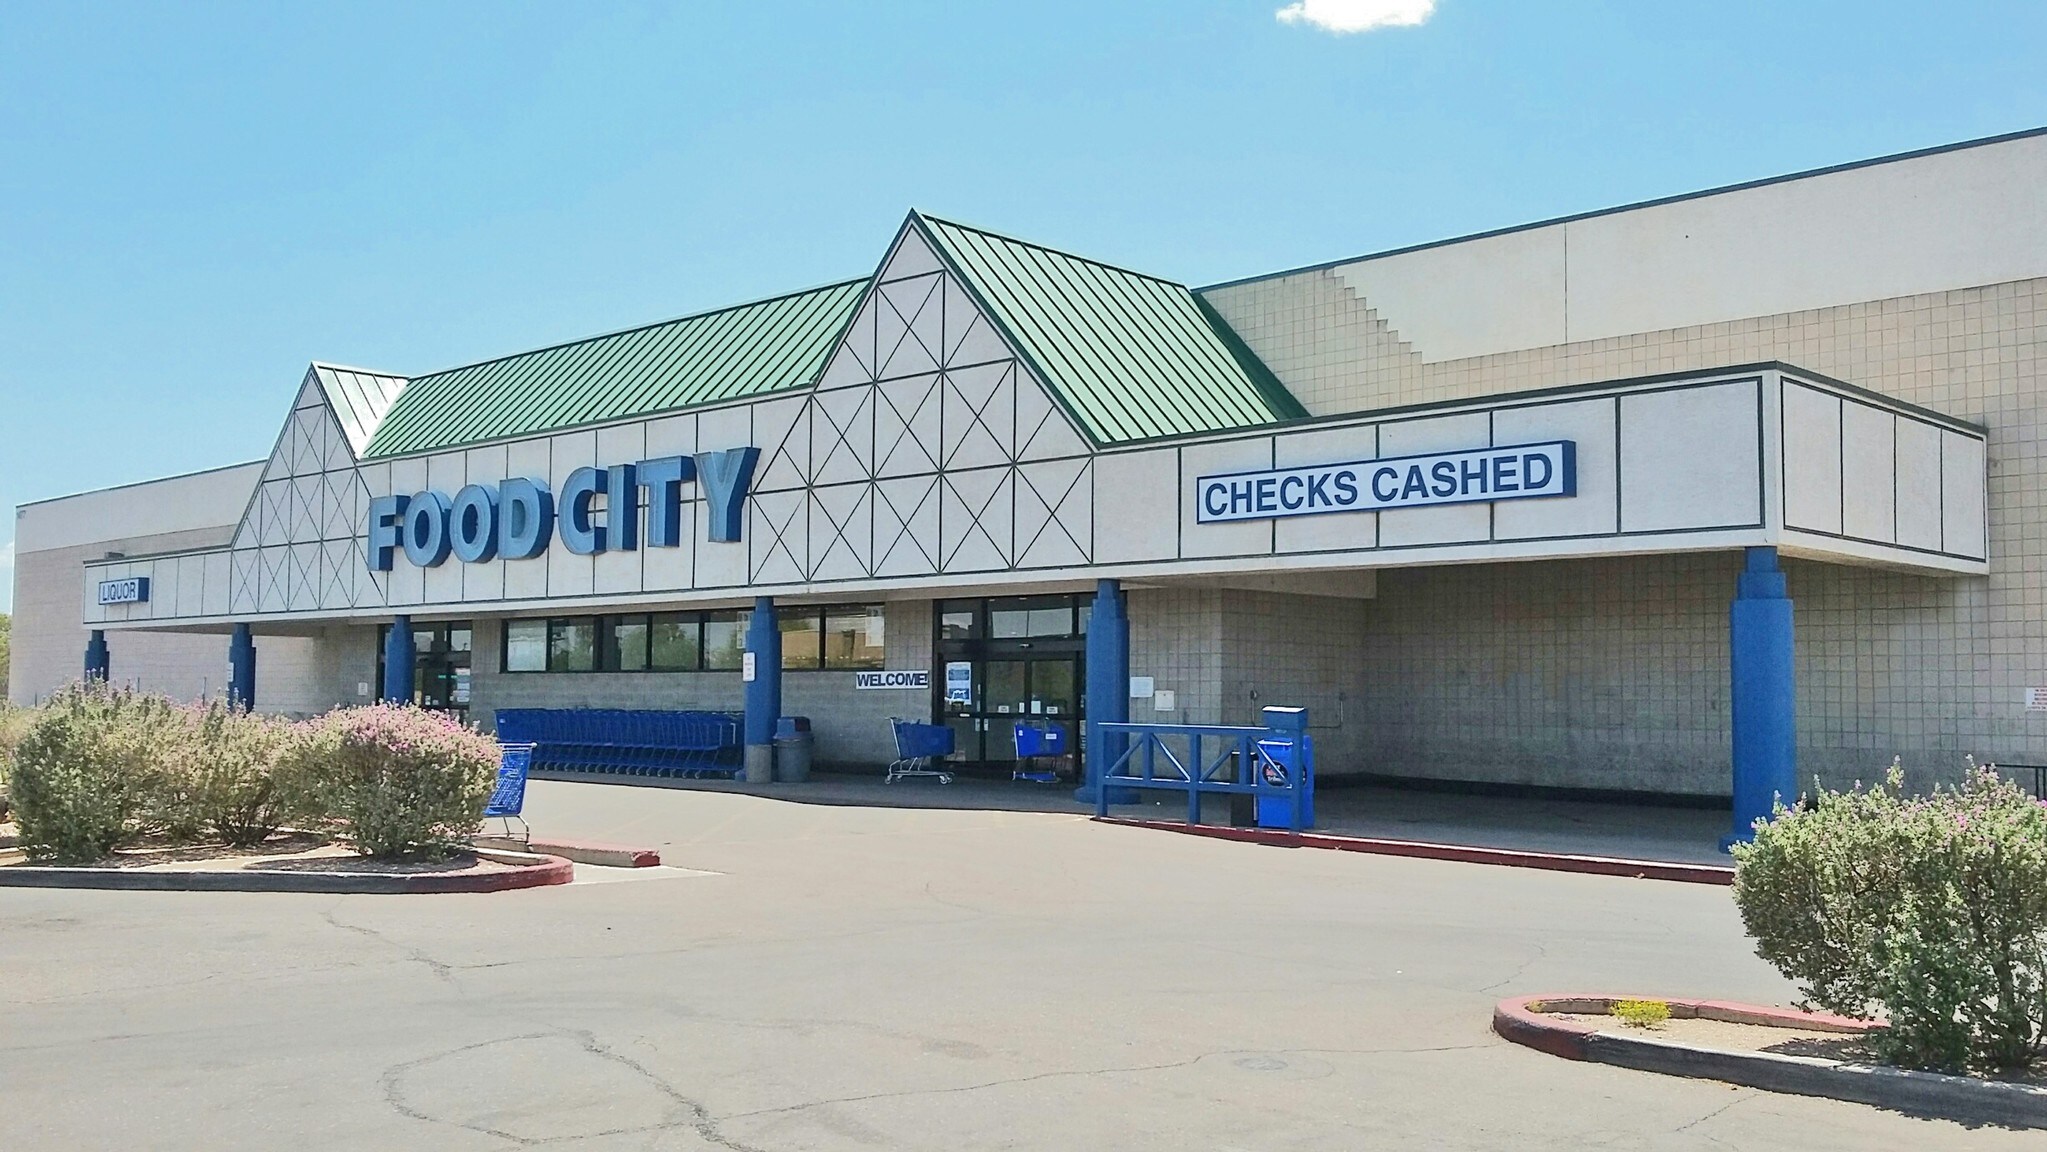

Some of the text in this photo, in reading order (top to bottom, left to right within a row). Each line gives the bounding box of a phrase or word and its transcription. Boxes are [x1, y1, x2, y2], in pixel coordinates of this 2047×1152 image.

[1205, 453, 1553, 516] CHECKS CASHED
[368, 447, 761, 571] FOOD CITY
[102, 581, 136, 601] LIQUOR
[857, 673, 928, 687] WELCOME!
